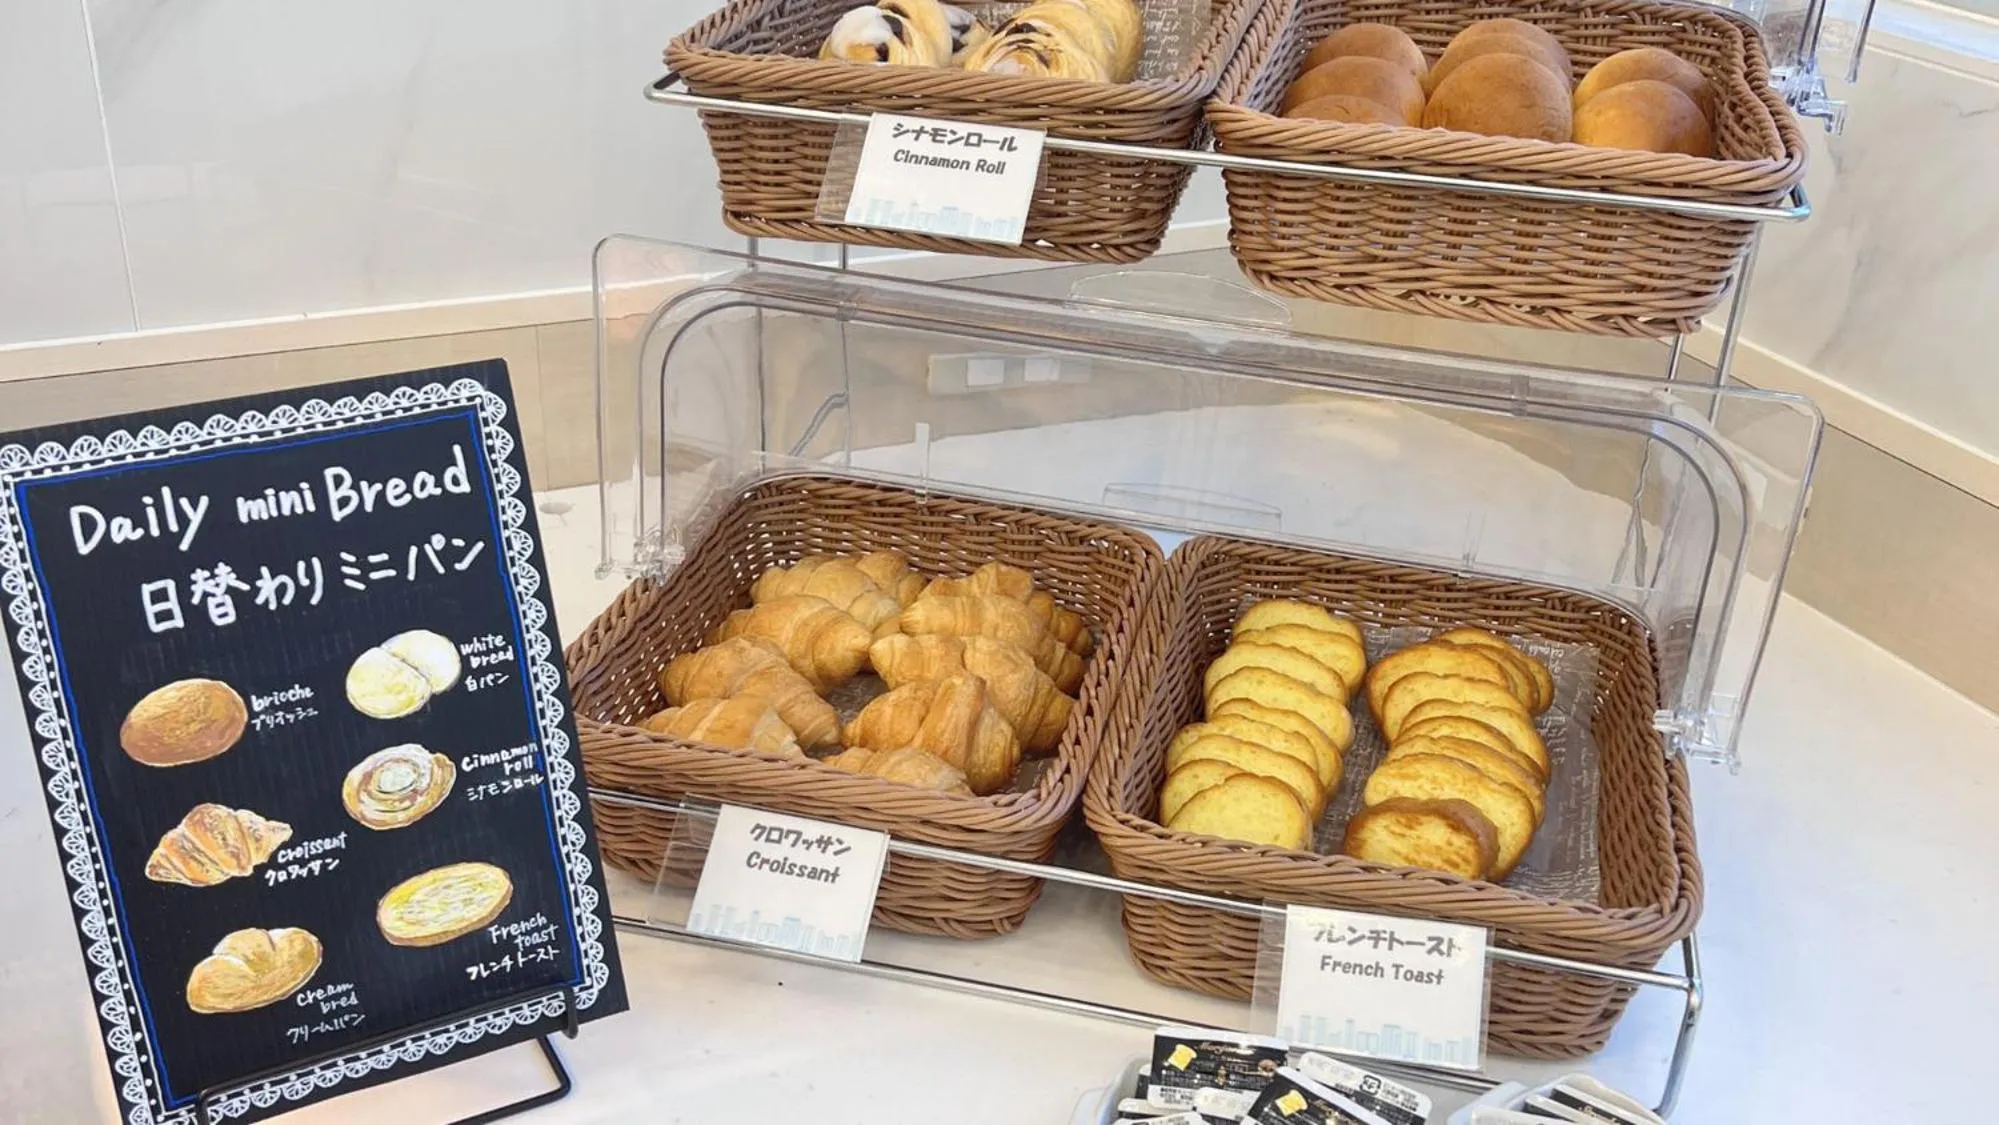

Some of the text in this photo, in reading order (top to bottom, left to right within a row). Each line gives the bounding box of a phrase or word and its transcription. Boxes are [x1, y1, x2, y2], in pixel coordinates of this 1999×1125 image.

[892, 122, 1018, 152] シナモンロール
[893, 148, 1007, 175] Cinnamon Roll
[69, 444, 471, 556] Daily mini Bread
[460, 633, 506, 656] white
[470, 645, 514, 669] bread
[464, 672, 510, 692] 白パン
[250, 683, 315, 712] brioche
[503, 754, 533, 776] roll
[749, 823, 852, 857] クロワッサン
[264, 858, 340, 887] クロワッサン
[746, 850, 840, 884] Croissant
[487, 912, 547, 944] French
[513, 924, 559, 951] toast
[466, 944, 560, 980] フレンチトースト
[1320, 954, 1444, 985] French Toast
[286, 1013, 366, 1044] クリームパン
